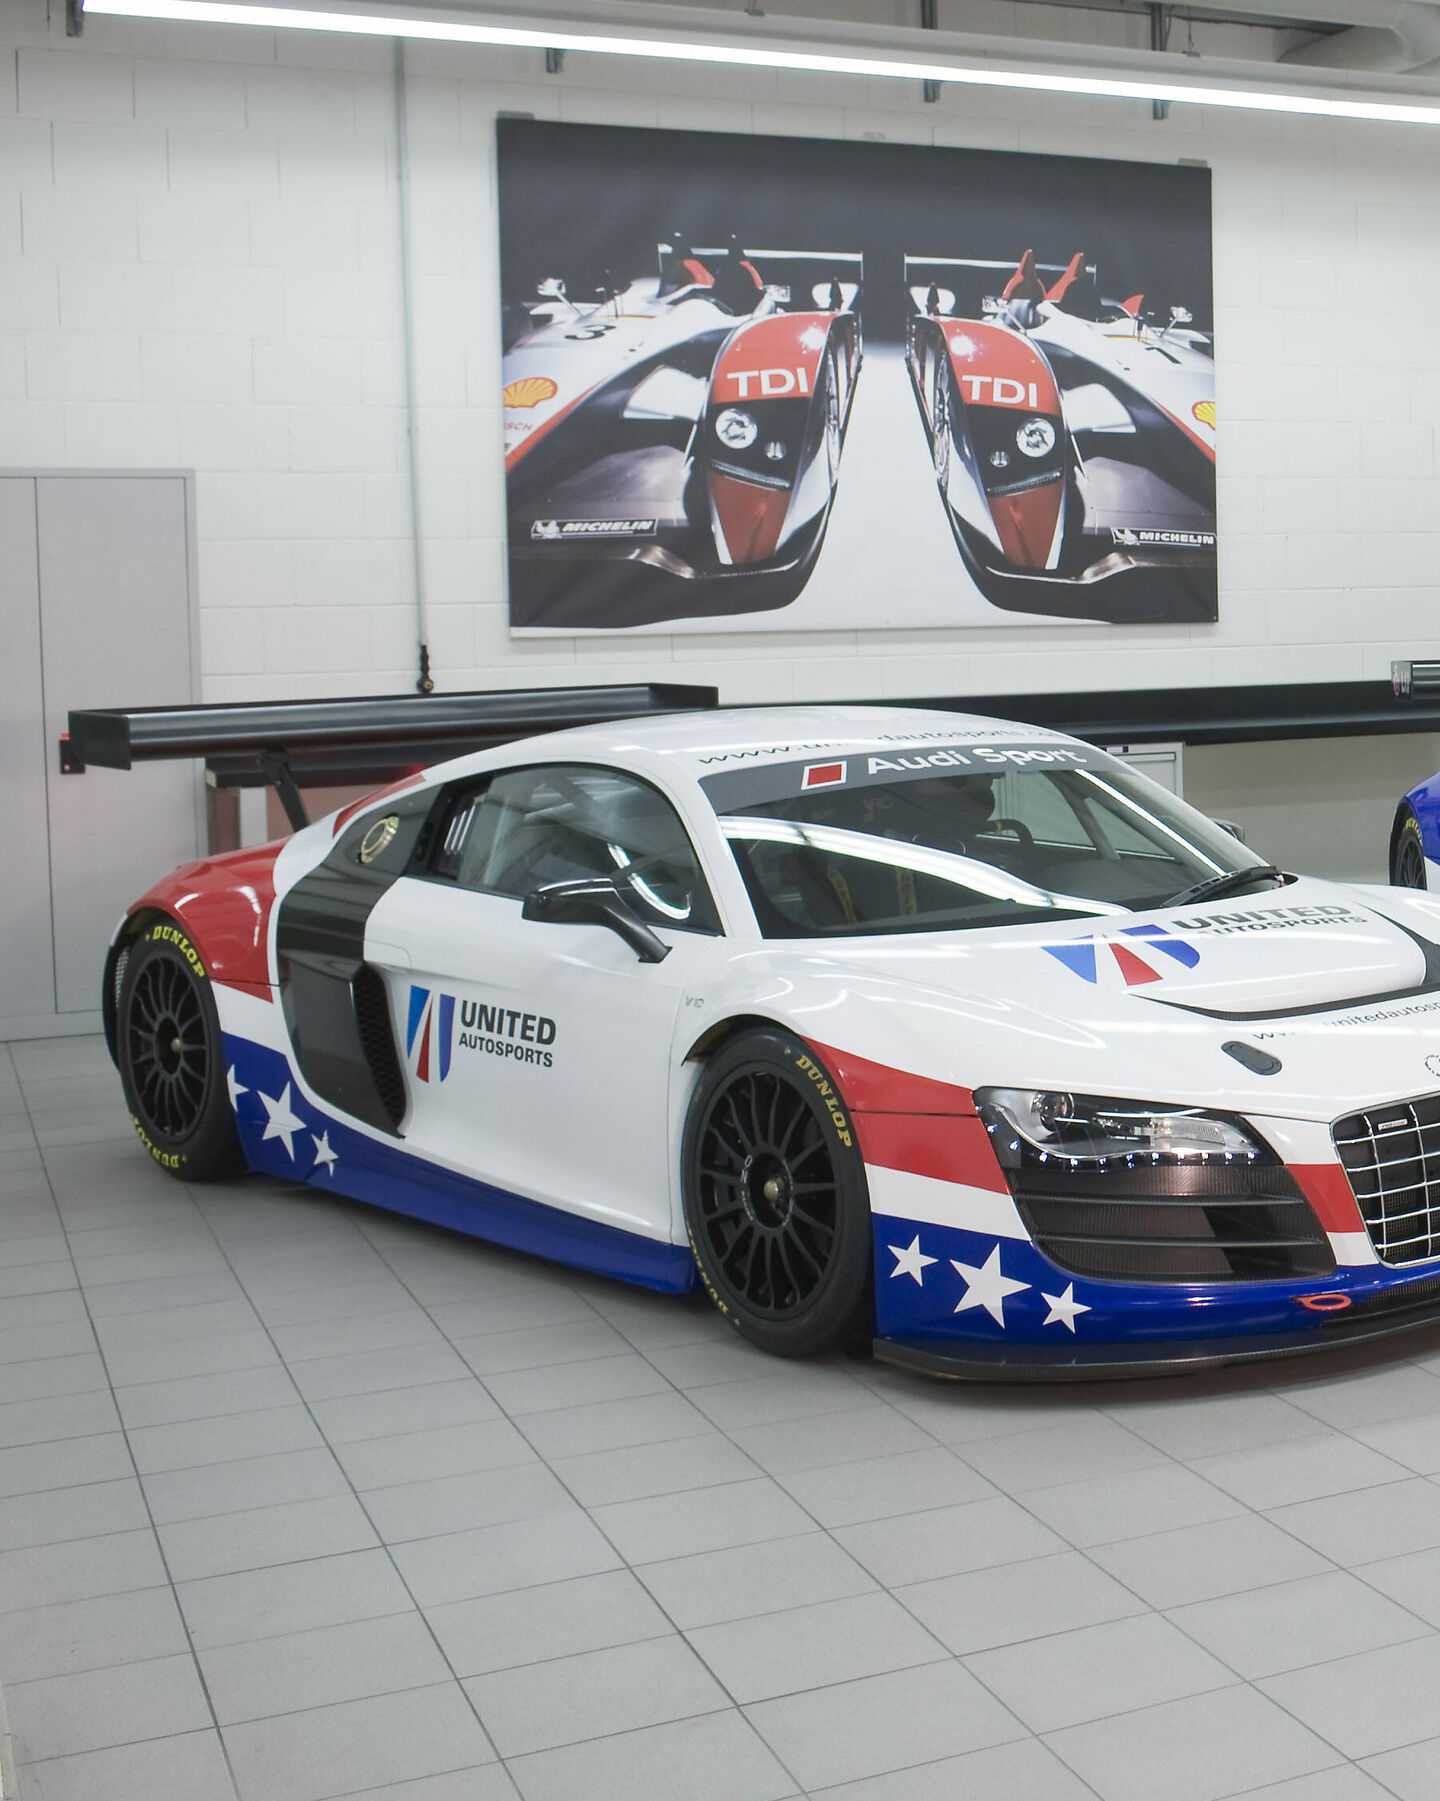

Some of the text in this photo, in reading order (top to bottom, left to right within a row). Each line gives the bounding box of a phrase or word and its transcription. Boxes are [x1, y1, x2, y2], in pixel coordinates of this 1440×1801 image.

[727, 367, 809, 397] TDI
[961, 375, 1038, 408] TDI
[562, 519, 653, 533] MICHELIN
[1139, 531, 1215, 545] MICHELIN
[868, 747, 1087, 775] Audi Sport
[1171, 905, 1352, 930] UNITED
[152, 924, 206, 979] DUNLOP
[460, 1000, 557, 1046] UNITED
[458, 1032, 554, 1068] AUTOSPORTS
[794, 1054, 852, 1148] DUNLOP
